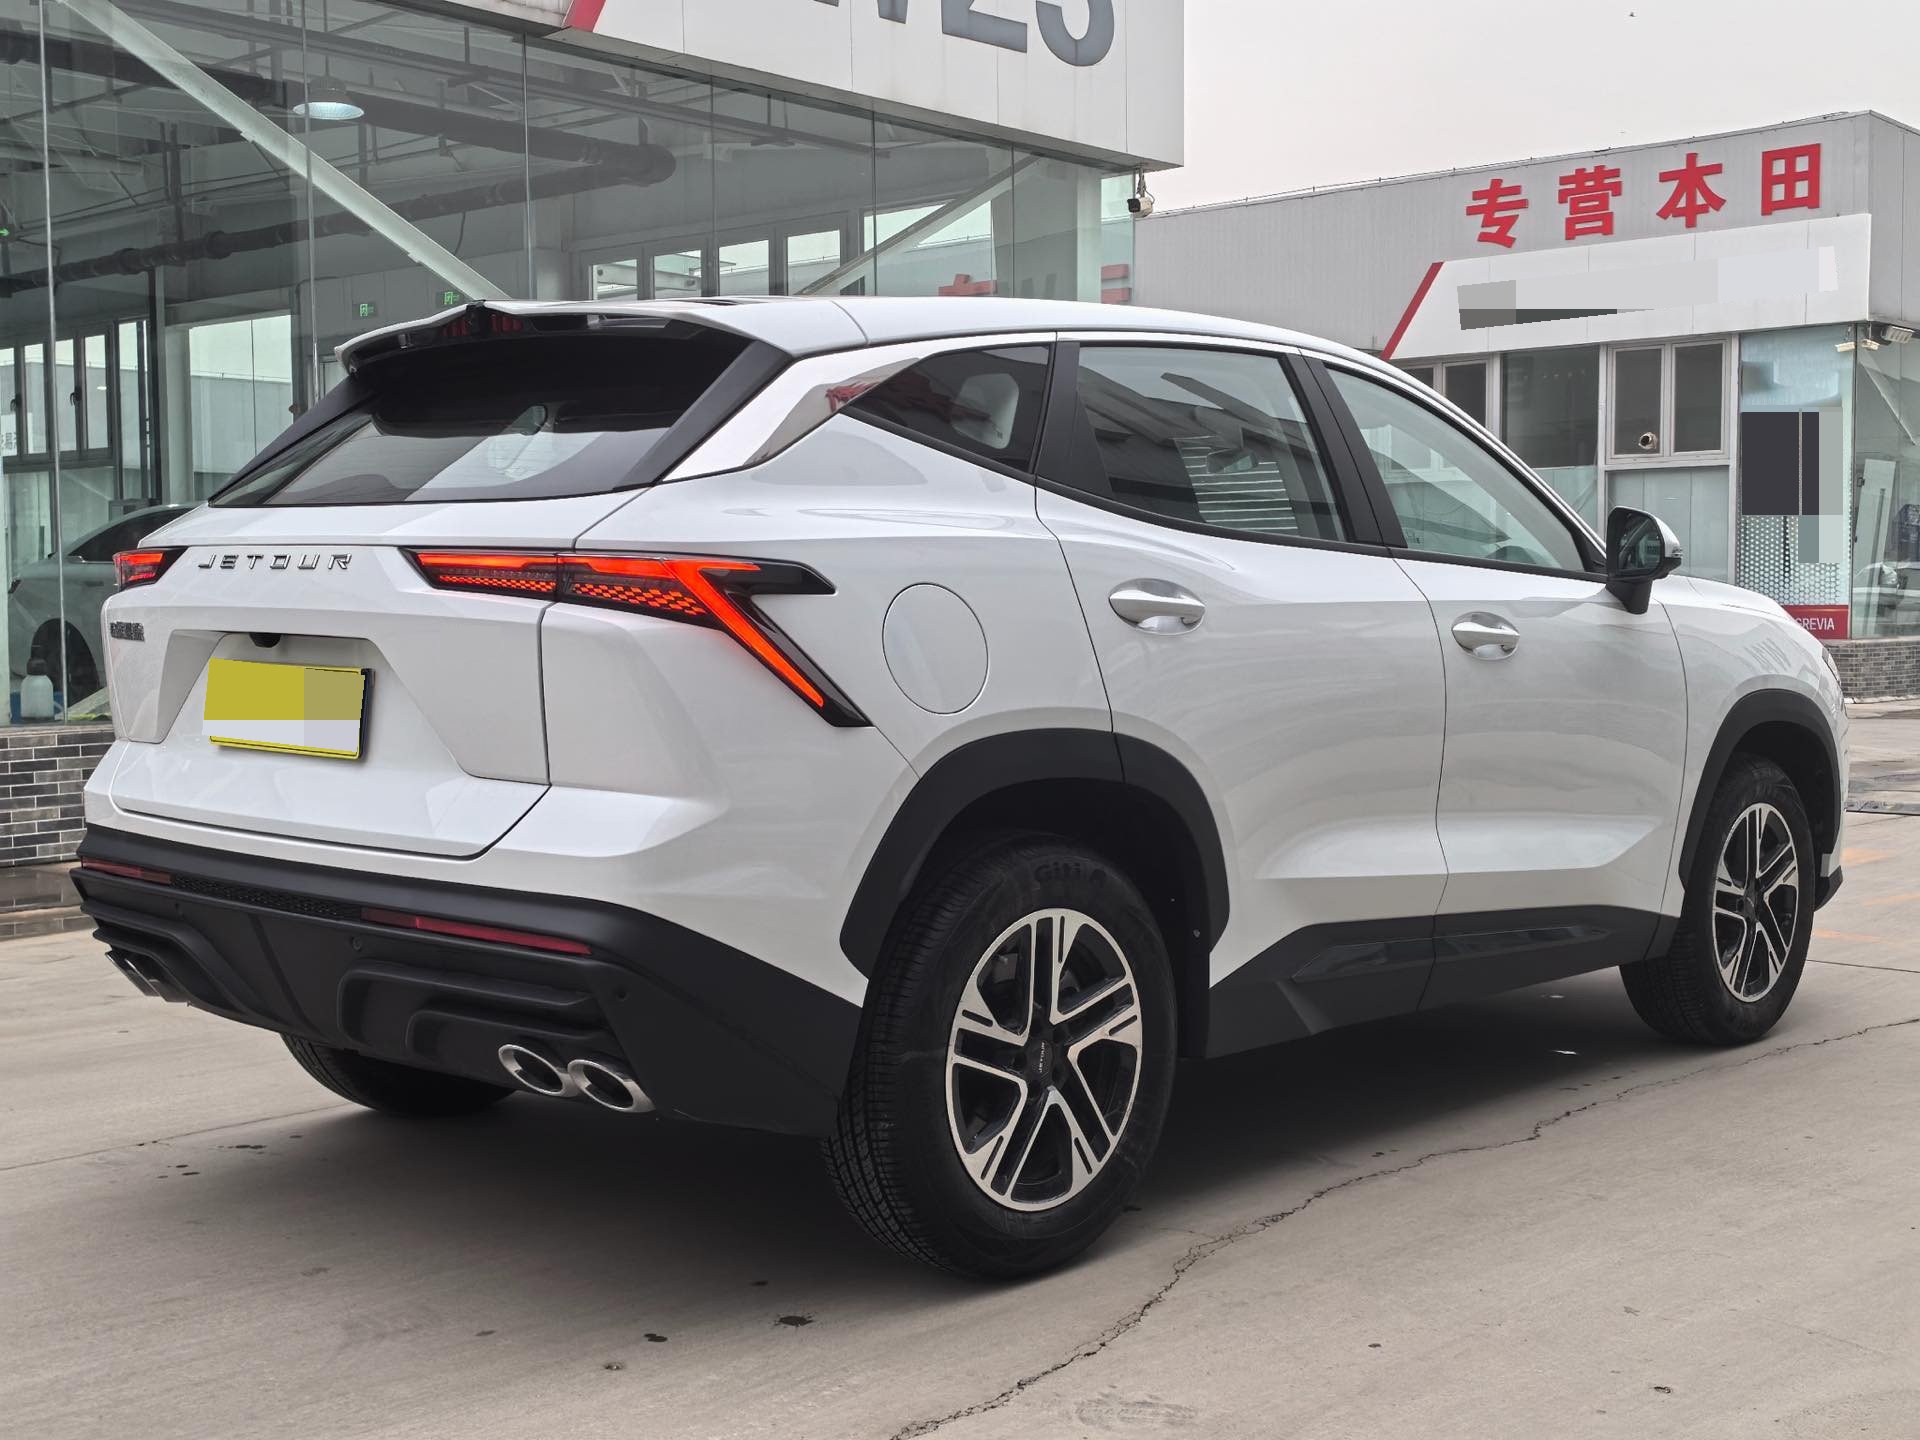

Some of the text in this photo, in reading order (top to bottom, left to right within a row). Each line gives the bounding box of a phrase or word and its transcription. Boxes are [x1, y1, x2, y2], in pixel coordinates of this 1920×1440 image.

[1465, 142, 1822, 249] 专营本田
[197, 552, 353, 571] JETOUR
